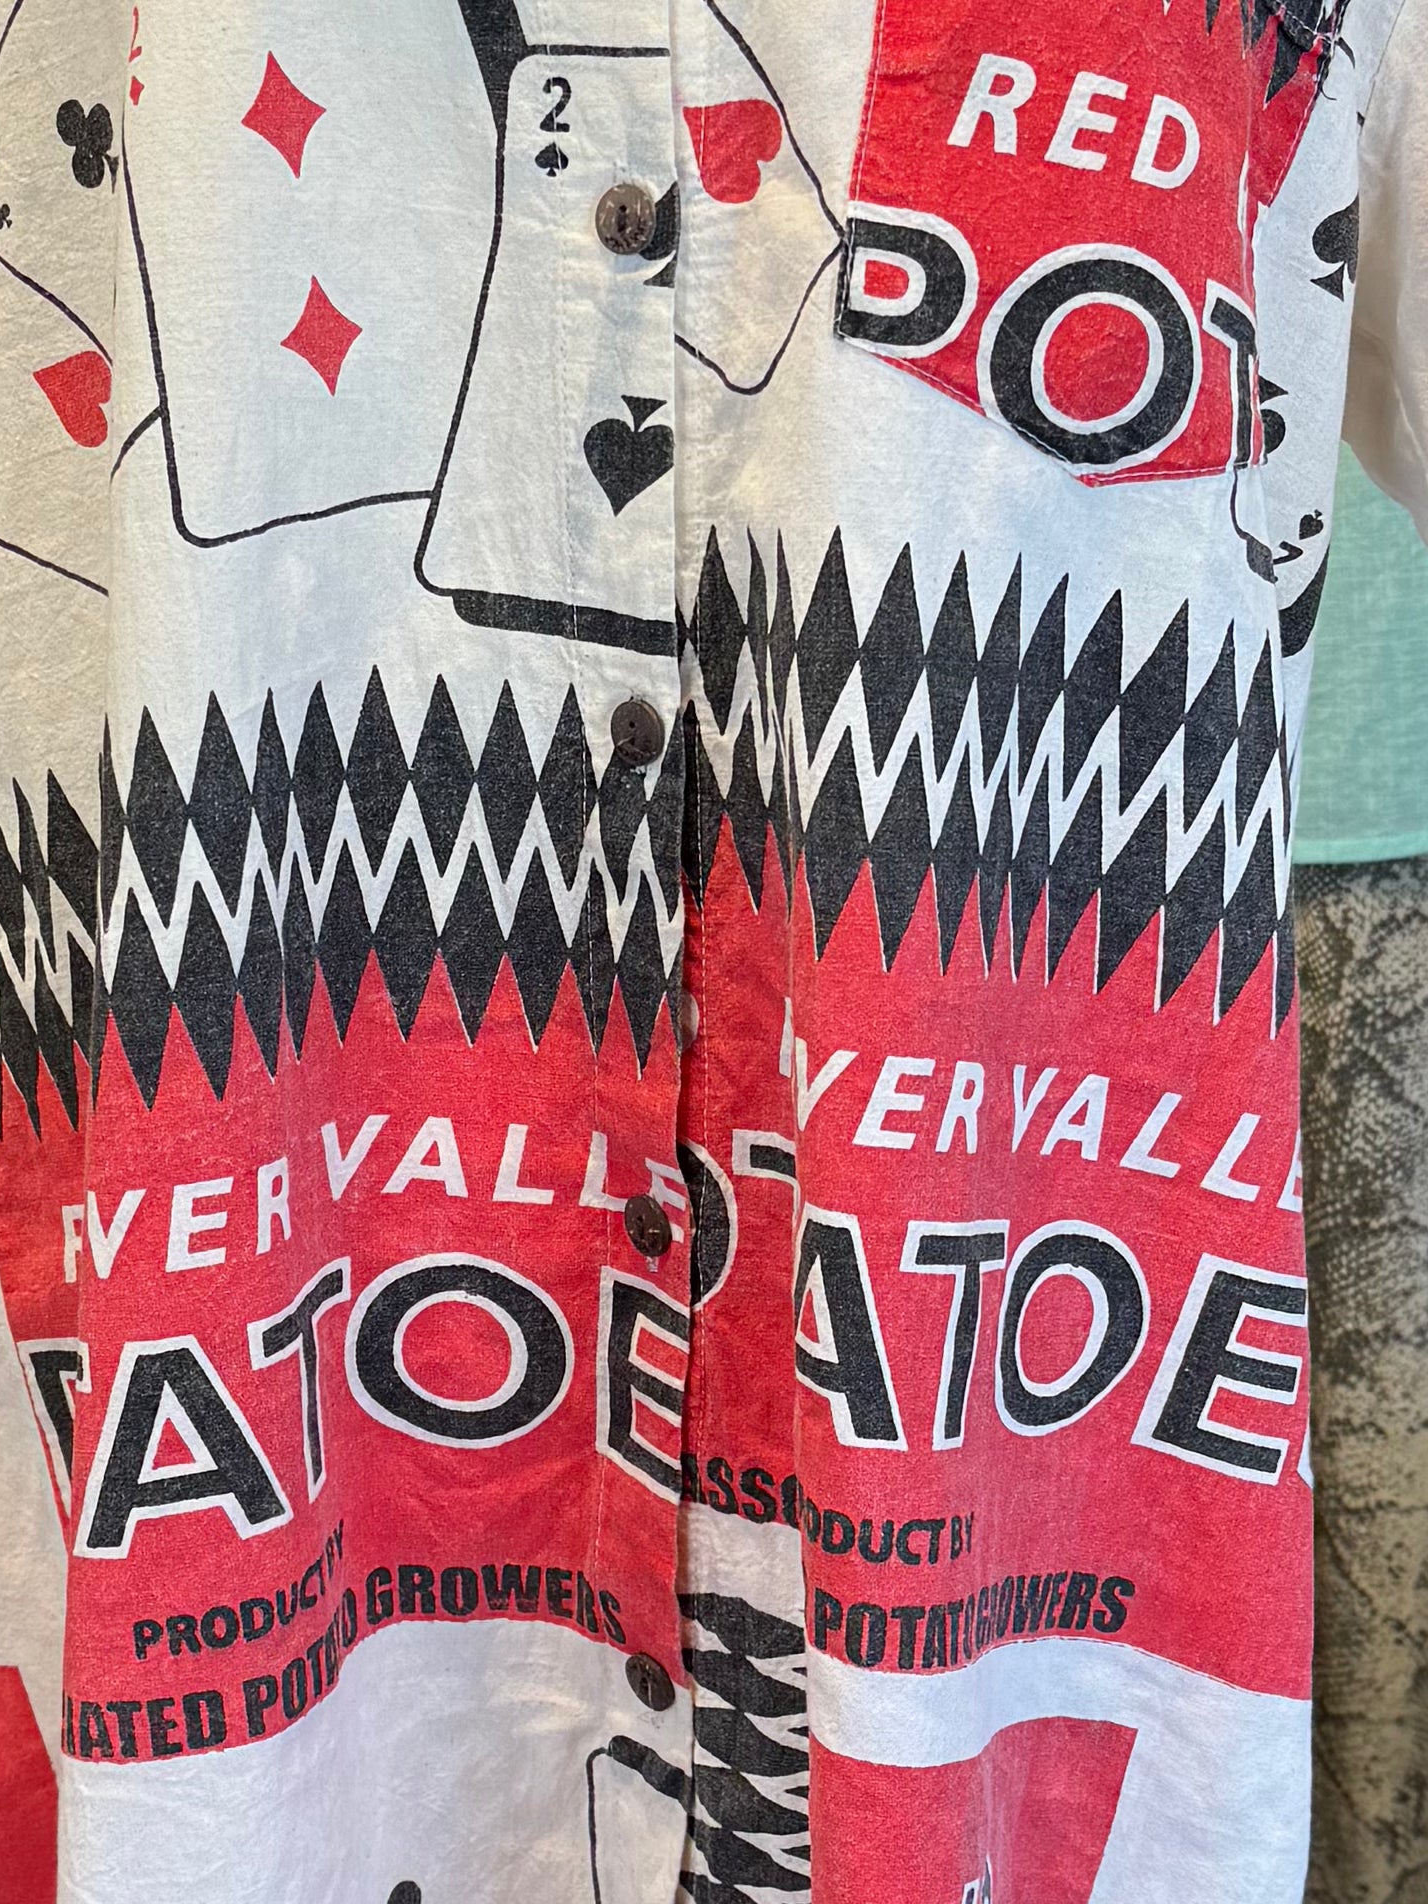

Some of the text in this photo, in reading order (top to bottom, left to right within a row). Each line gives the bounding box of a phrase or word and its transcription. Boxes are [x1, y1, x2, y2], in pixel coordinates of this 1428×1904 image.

[542, 76, 572, 135] 2
[947, 52, 1201, 191] RED
[365, 1562, 629, 1645] GROWERS
